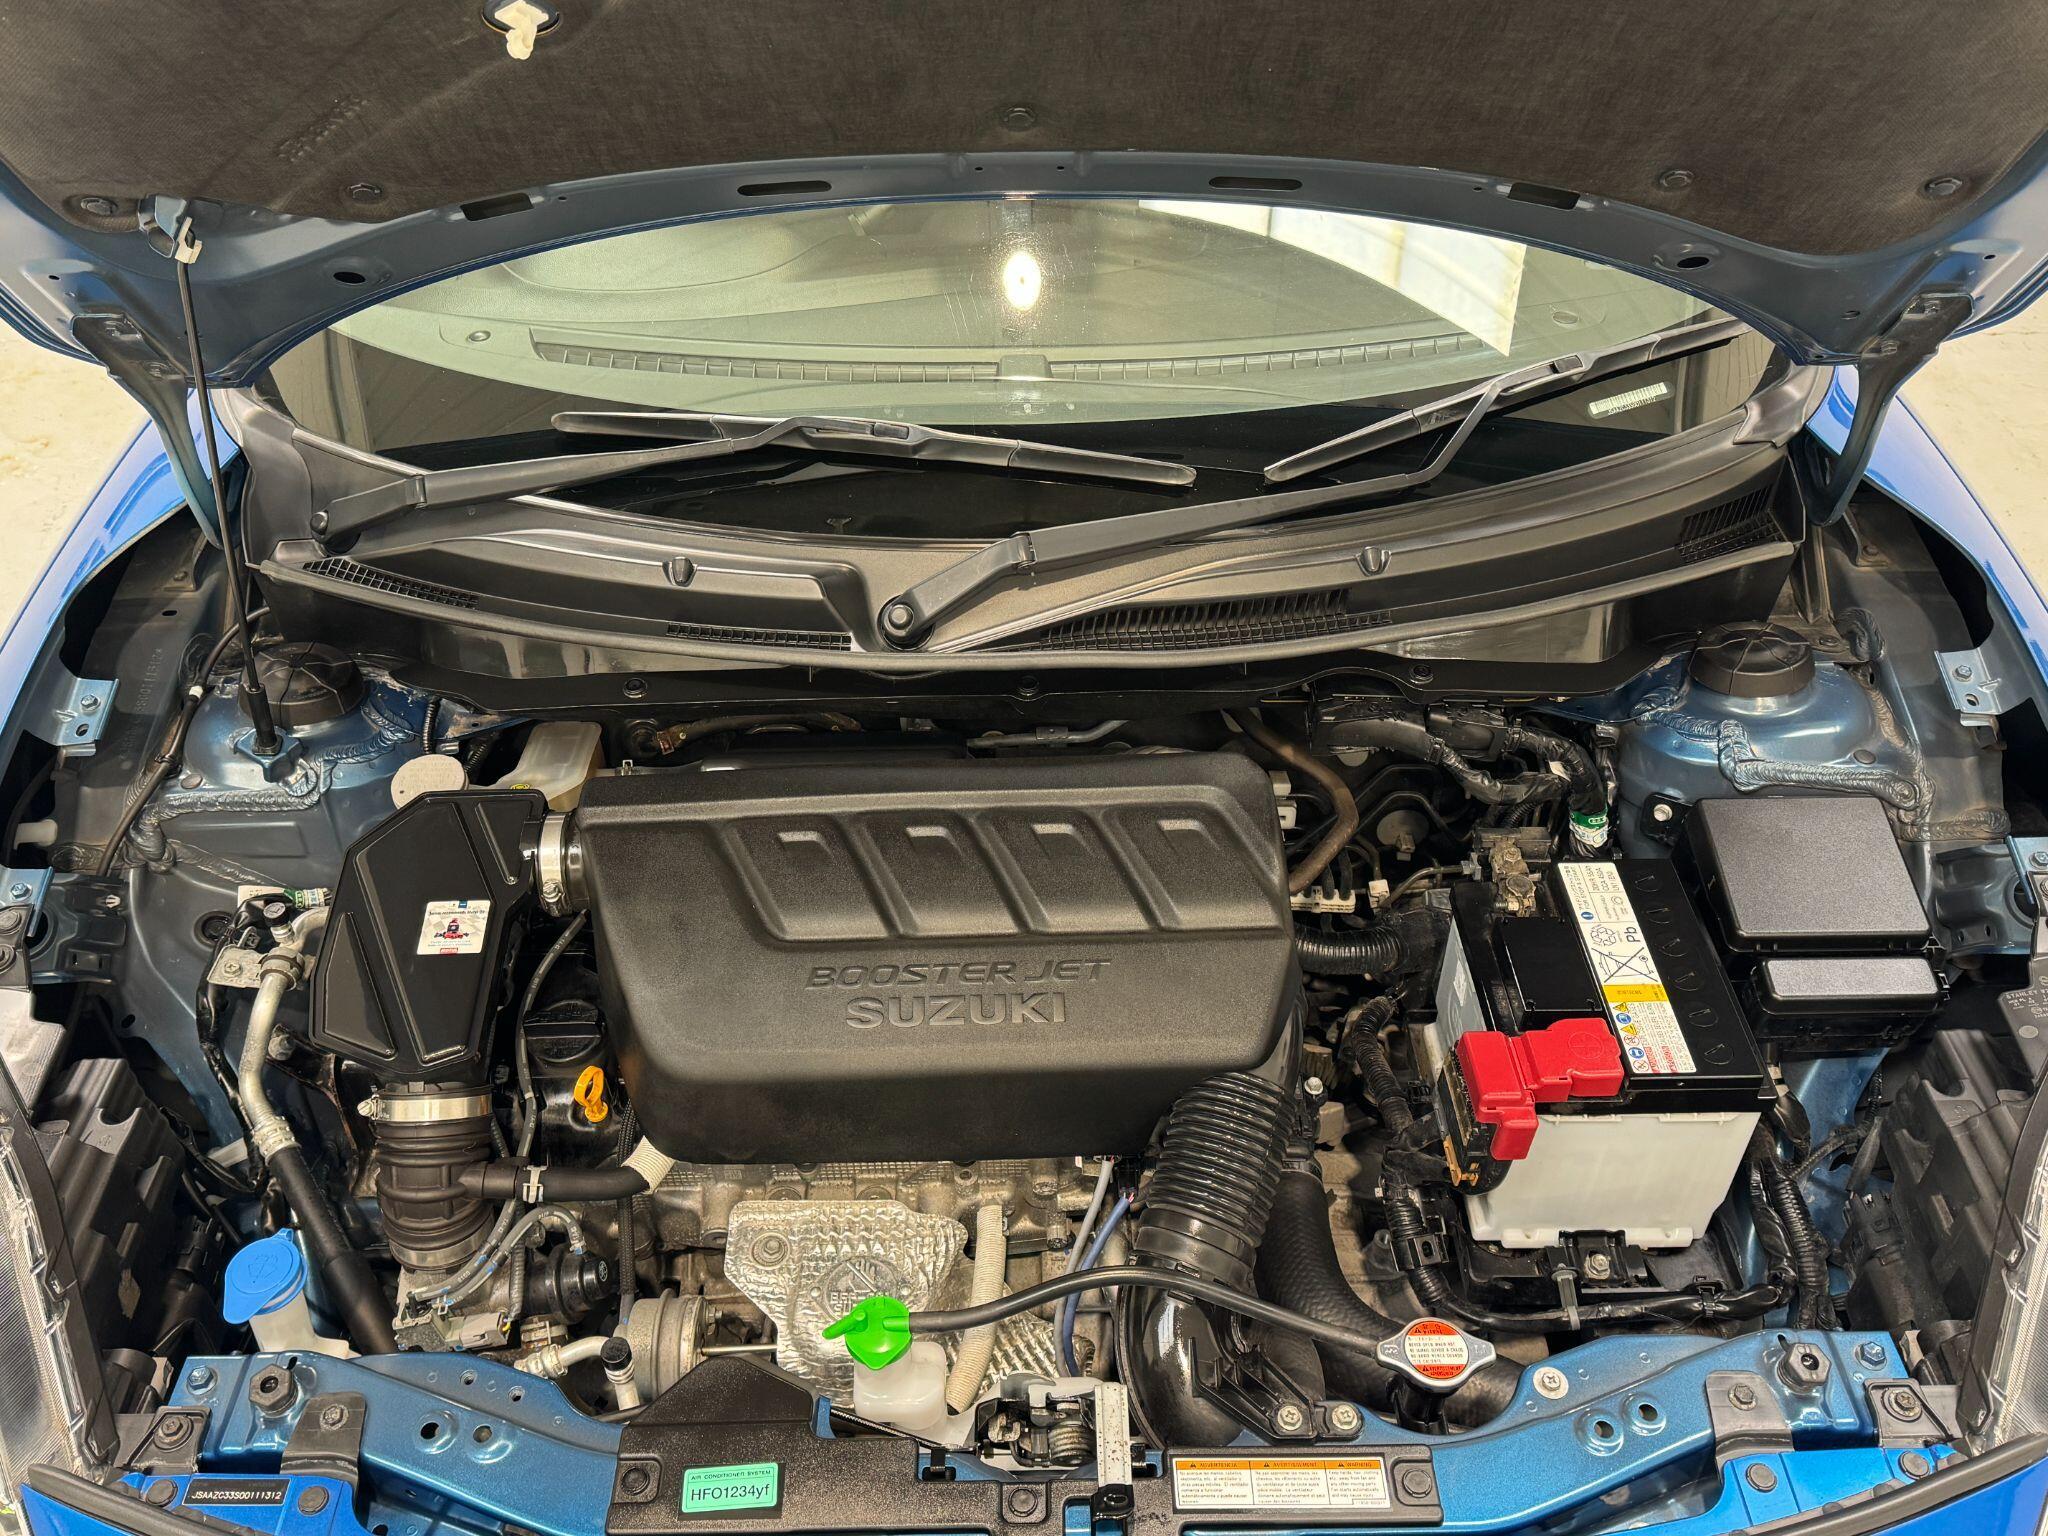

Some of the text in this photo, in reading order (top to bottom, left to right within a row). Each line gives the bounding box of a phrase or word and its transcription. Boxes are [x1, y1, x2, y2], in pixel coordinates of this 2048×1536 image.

[1621, 926, 1640, 942] Pb
[805, 959, 1111, 990] BOOSTER JET
[2006, 990, 2038, 999] STANLEY
[846, 991, 1067, 1029] SUZUKI
[704, 1472, 745, 1480] CONDITIONER
[747, 1469, 771, 1477] SYSTEM
[191, 1491, 282, 1500] JSAAZC33S00111312
[691, 1483, 770, 1501] HFO1234yf
